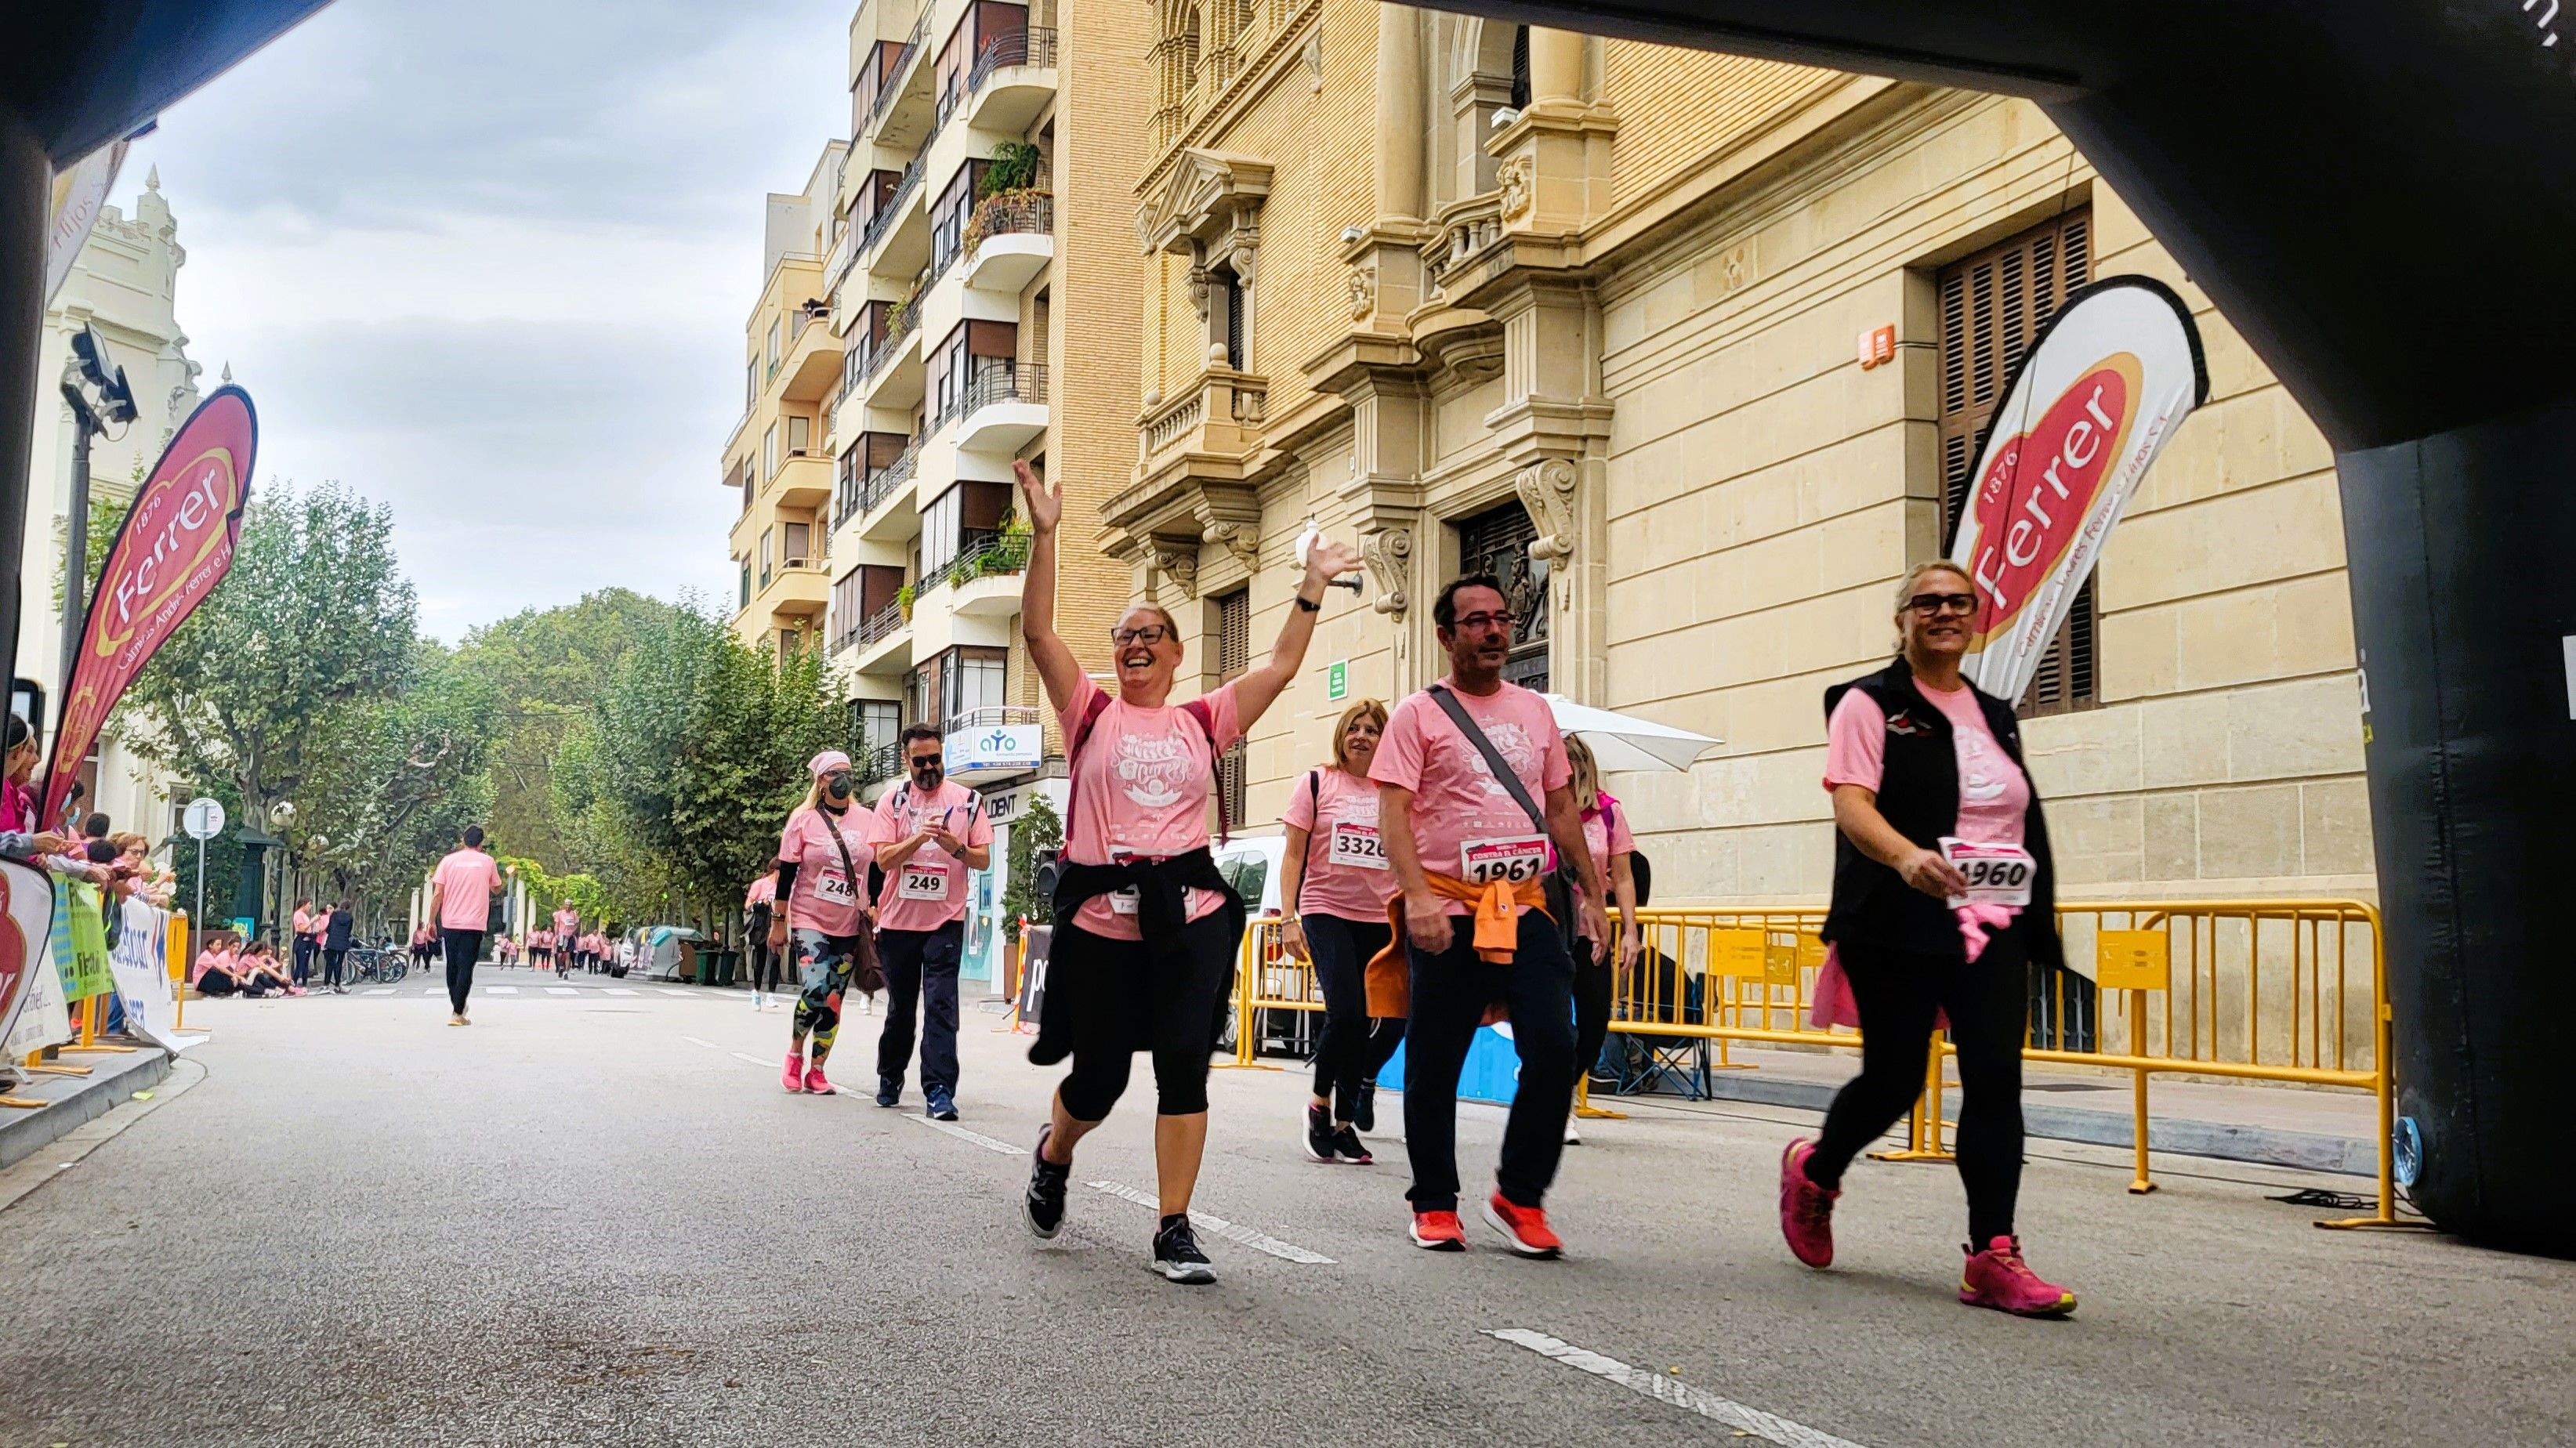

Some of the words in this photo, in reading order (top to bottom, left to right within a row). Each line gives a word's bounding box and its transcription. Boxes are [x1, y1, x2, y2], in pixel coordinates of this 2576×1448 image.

[1983, 449, 2019, 504] 1876
[1975, 384, 2114, 610] Ferrer
[117, 469, 219, 624] Ferrer
[213, 556, 222, 570] e
[1337, 835, 1387, 858] 3326
[908, 874, 940, 891] 249
[1473, 857, 1540, 884] 1961
[825, 879, 853, 898] 248
